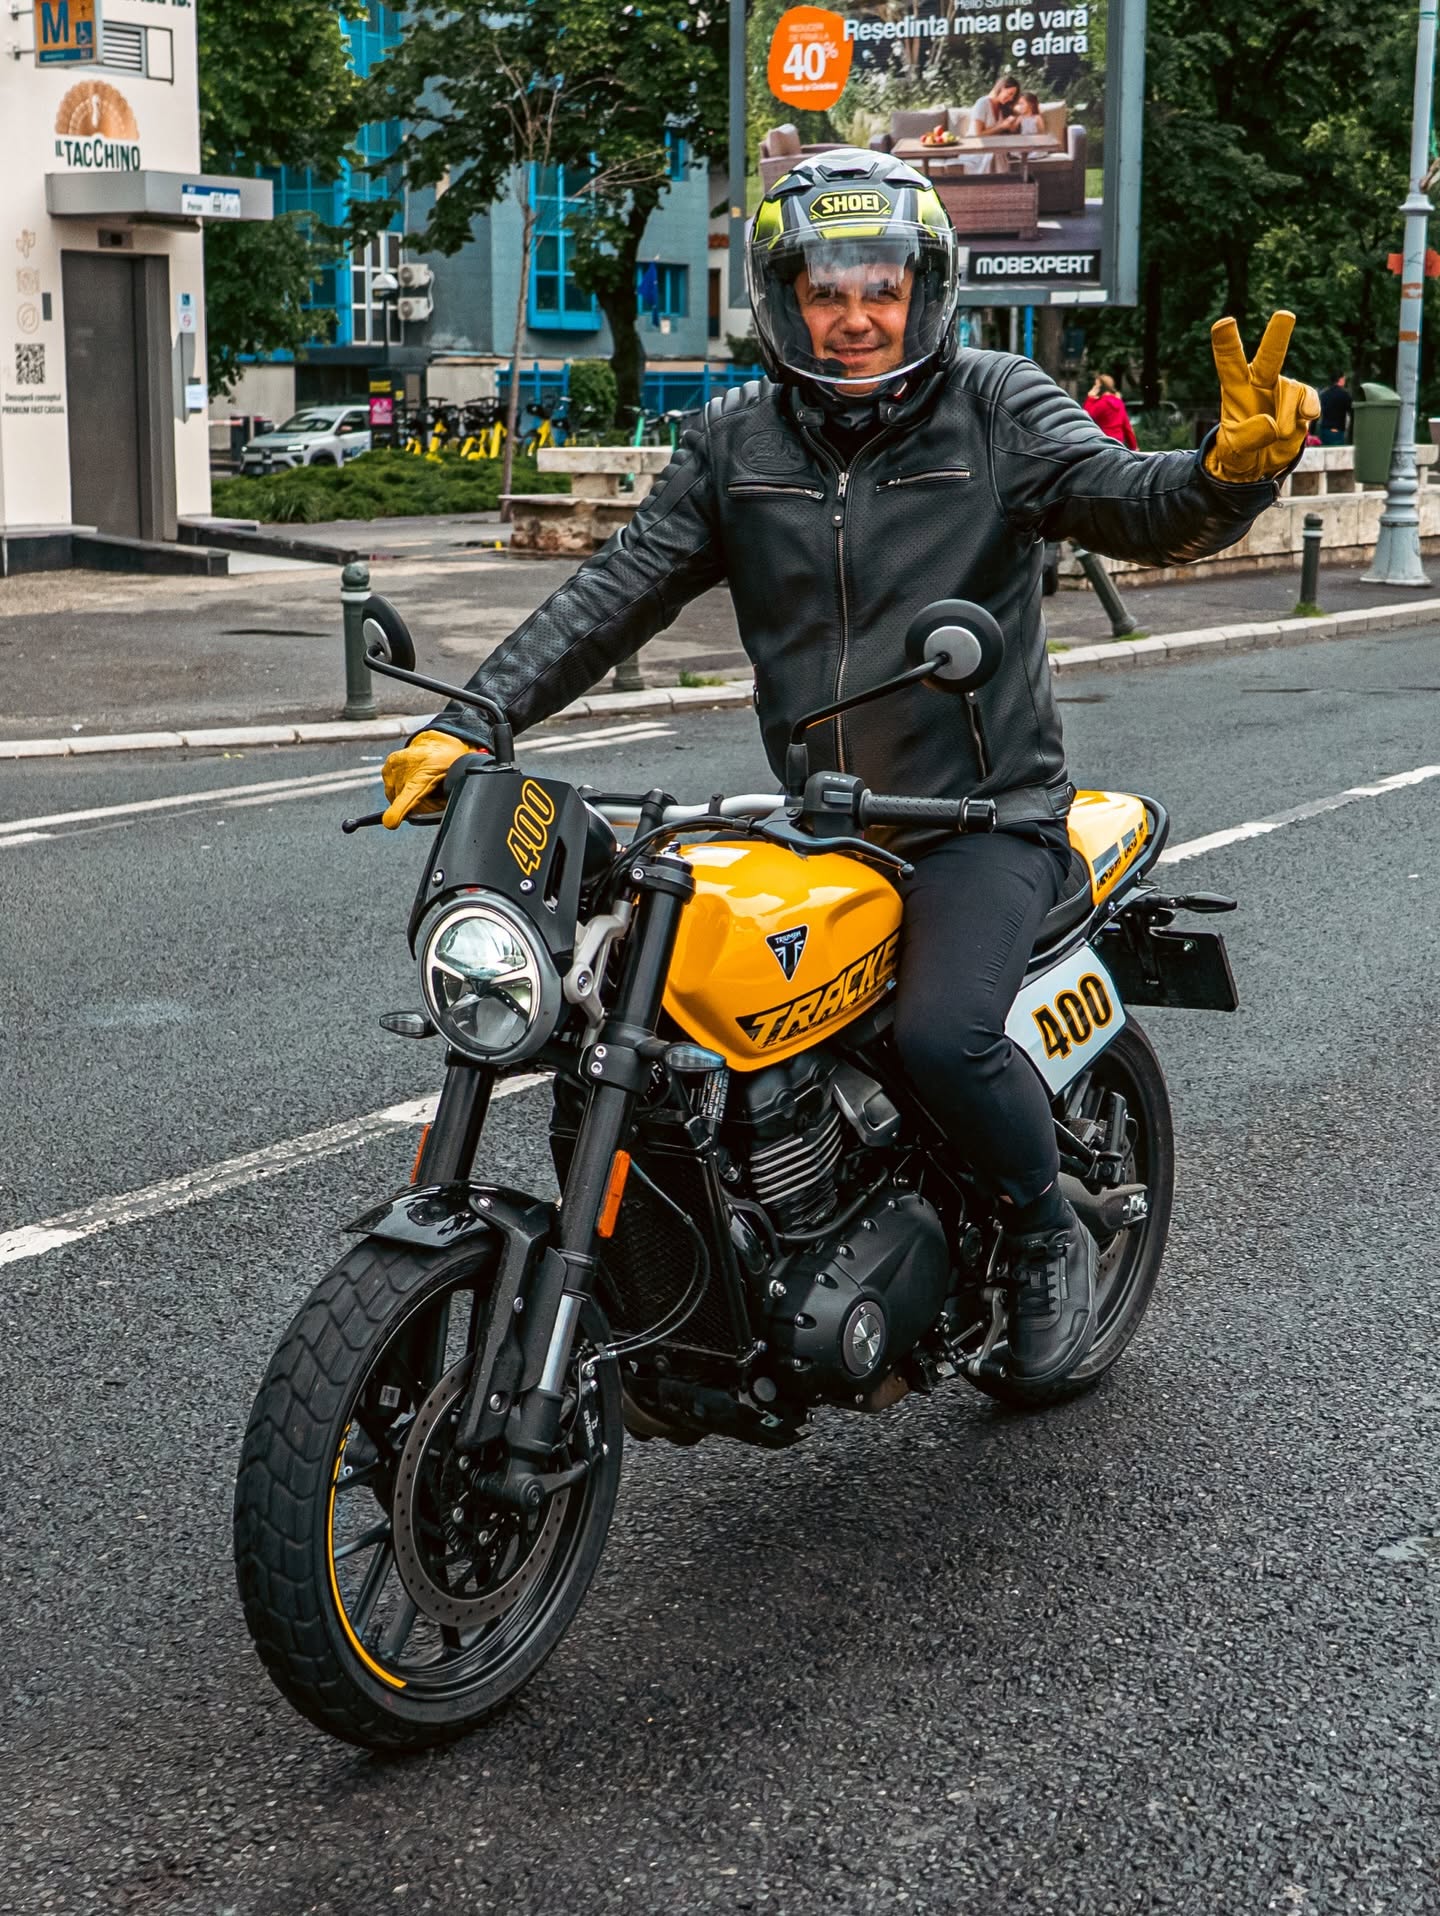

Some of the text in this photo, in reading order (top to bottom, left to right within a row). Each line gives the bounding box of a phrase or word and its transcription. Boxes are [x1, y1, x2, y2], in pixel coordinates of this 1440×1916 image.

[41, 1, 69, 44] M
[954, 16, 1001, 35] mea
[1006, 8, 1034, 32] de
[1039, 3, 1088, 29] vară
[1012, 30, 1088, 57] e afară
[821, 194, 880, 214] SHOEI
[975, 255, 1095, 275] MOBEXPERT
[506, 779, 555, 876] 400
[1031, 972, 1114, 1060] 400
